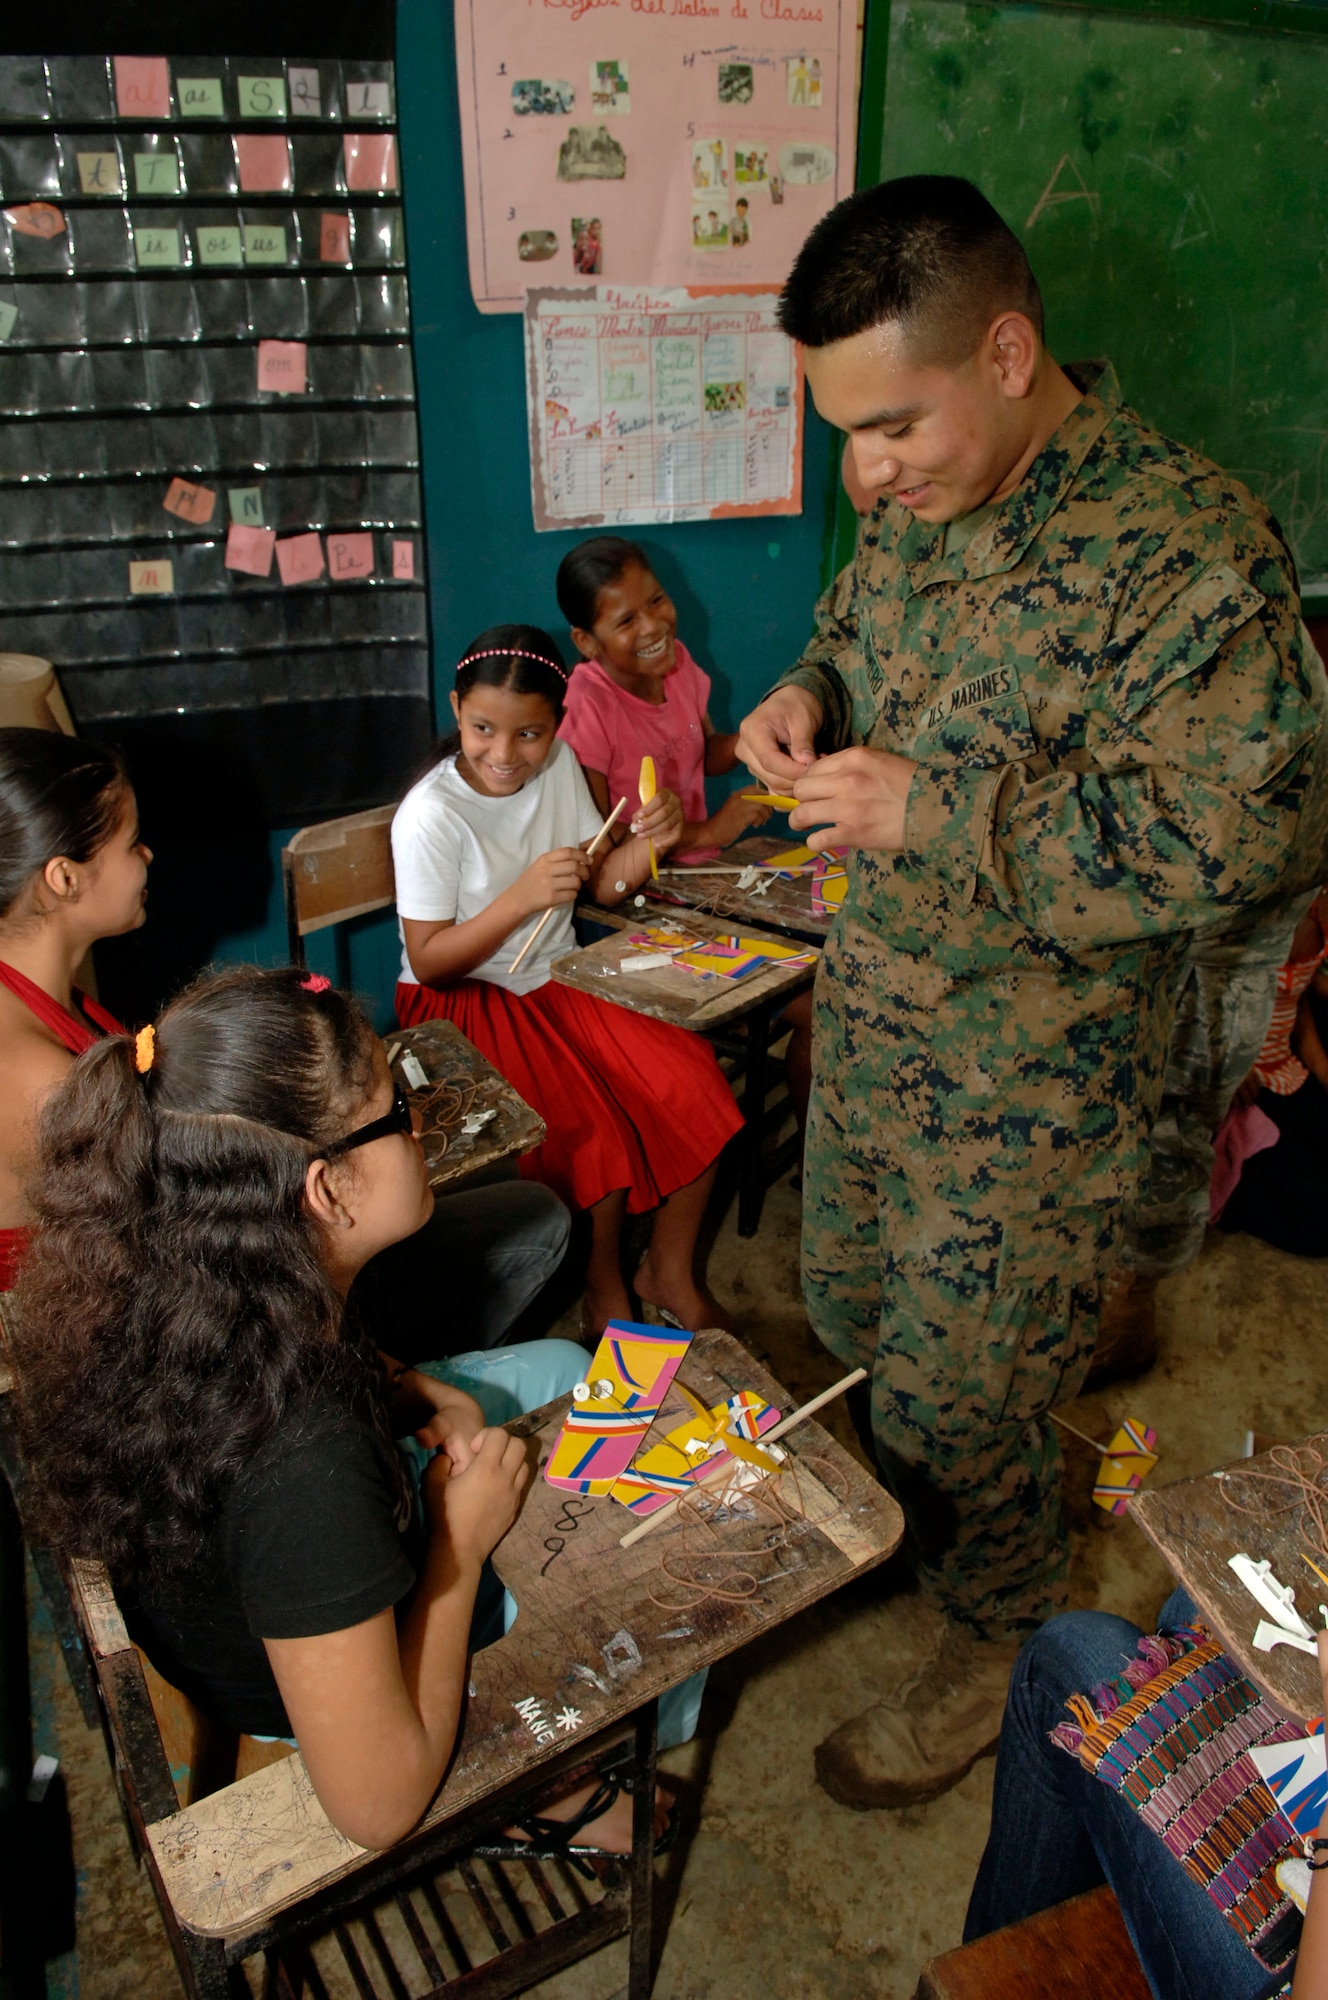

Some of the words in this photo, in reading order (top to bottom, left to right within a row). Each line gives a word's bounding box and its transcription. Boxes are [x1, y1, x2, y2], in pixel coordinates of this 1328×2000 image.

[495, 63, 507, 75] 1
[143, 159, 164, 185] T
[243, 495, 259, 517] N
[928, 700, 945, 728] U.S.
[950, 669, 1012, 713] MARINES
[554, 1499, 596, 1532] 8
